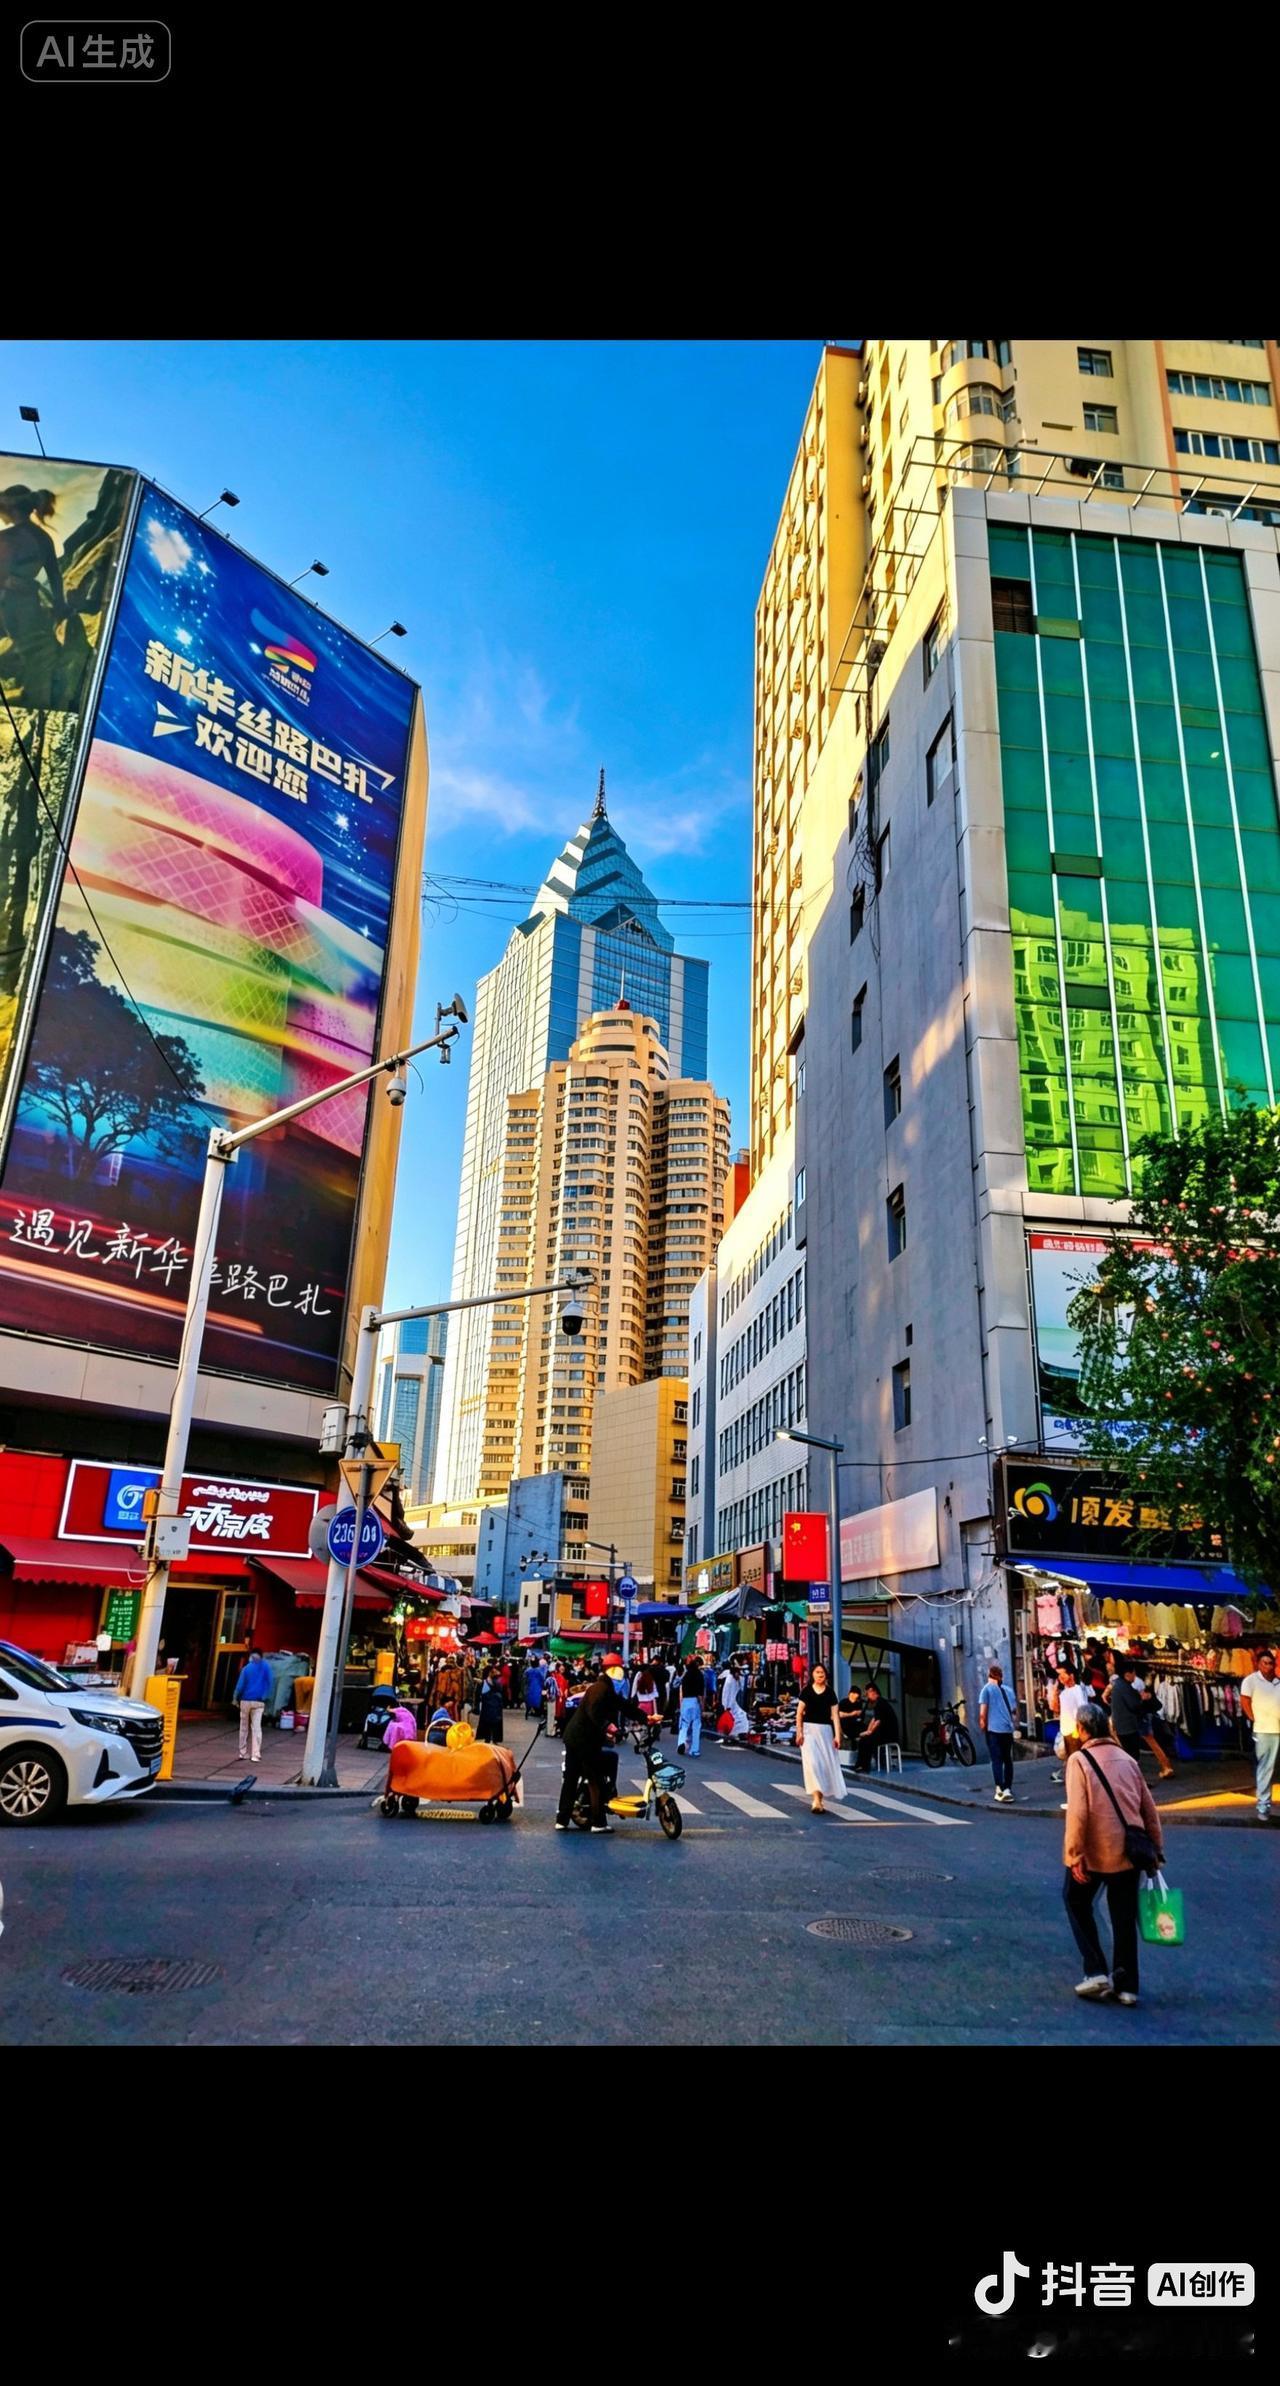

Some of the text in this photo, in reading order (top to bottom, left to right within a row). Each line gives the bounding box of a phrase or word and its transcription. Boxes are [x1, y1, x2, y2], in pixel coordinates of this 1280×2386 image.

[144, 640, 375, 804] 新华丝路巴扎
[195, 713, 308, 804] 欢迎您
